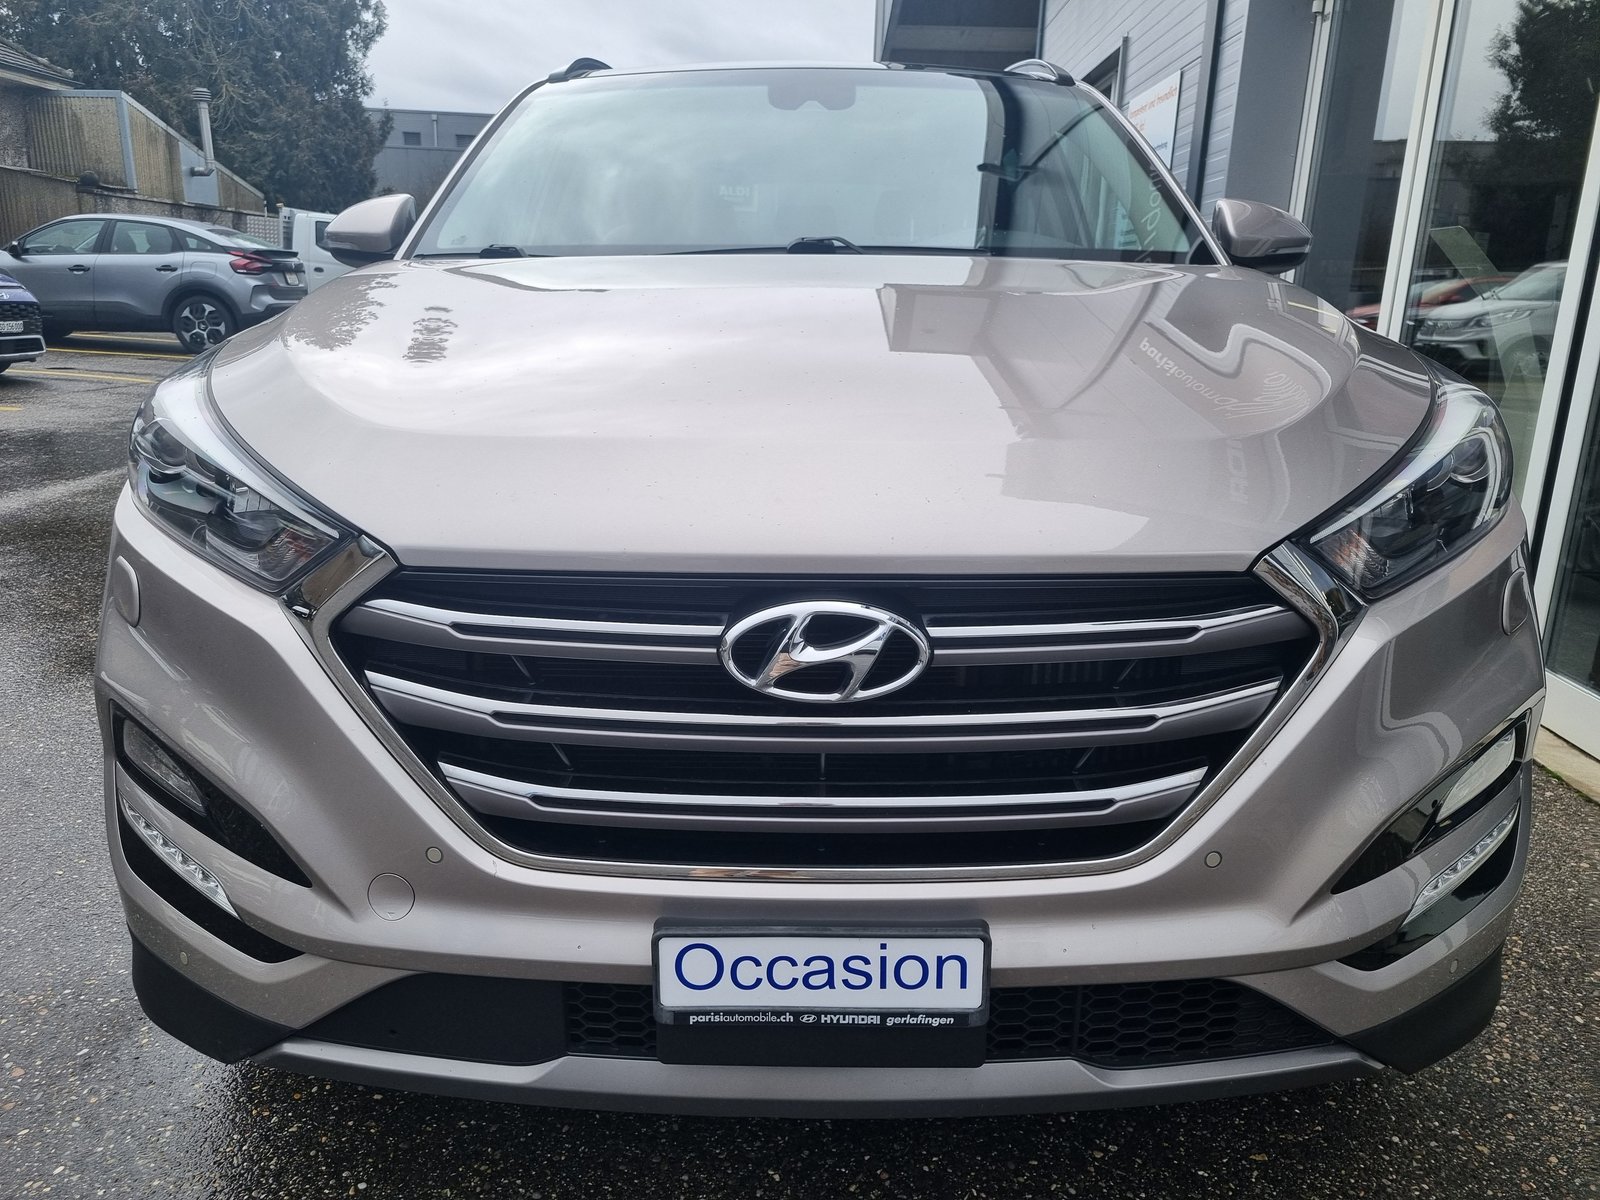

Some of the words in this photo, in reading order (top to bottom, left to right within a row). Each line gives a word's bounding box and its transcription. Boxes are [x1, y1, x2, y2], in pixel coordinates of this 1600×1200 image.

[674, 942, 969, 991] Occasion
[689, 1011, 794, 1025] parisiautomobile.ch
[821, 1014, 881, 1025] HYUNDAI
[886, 1013, 954, 1027] gerlafingen
